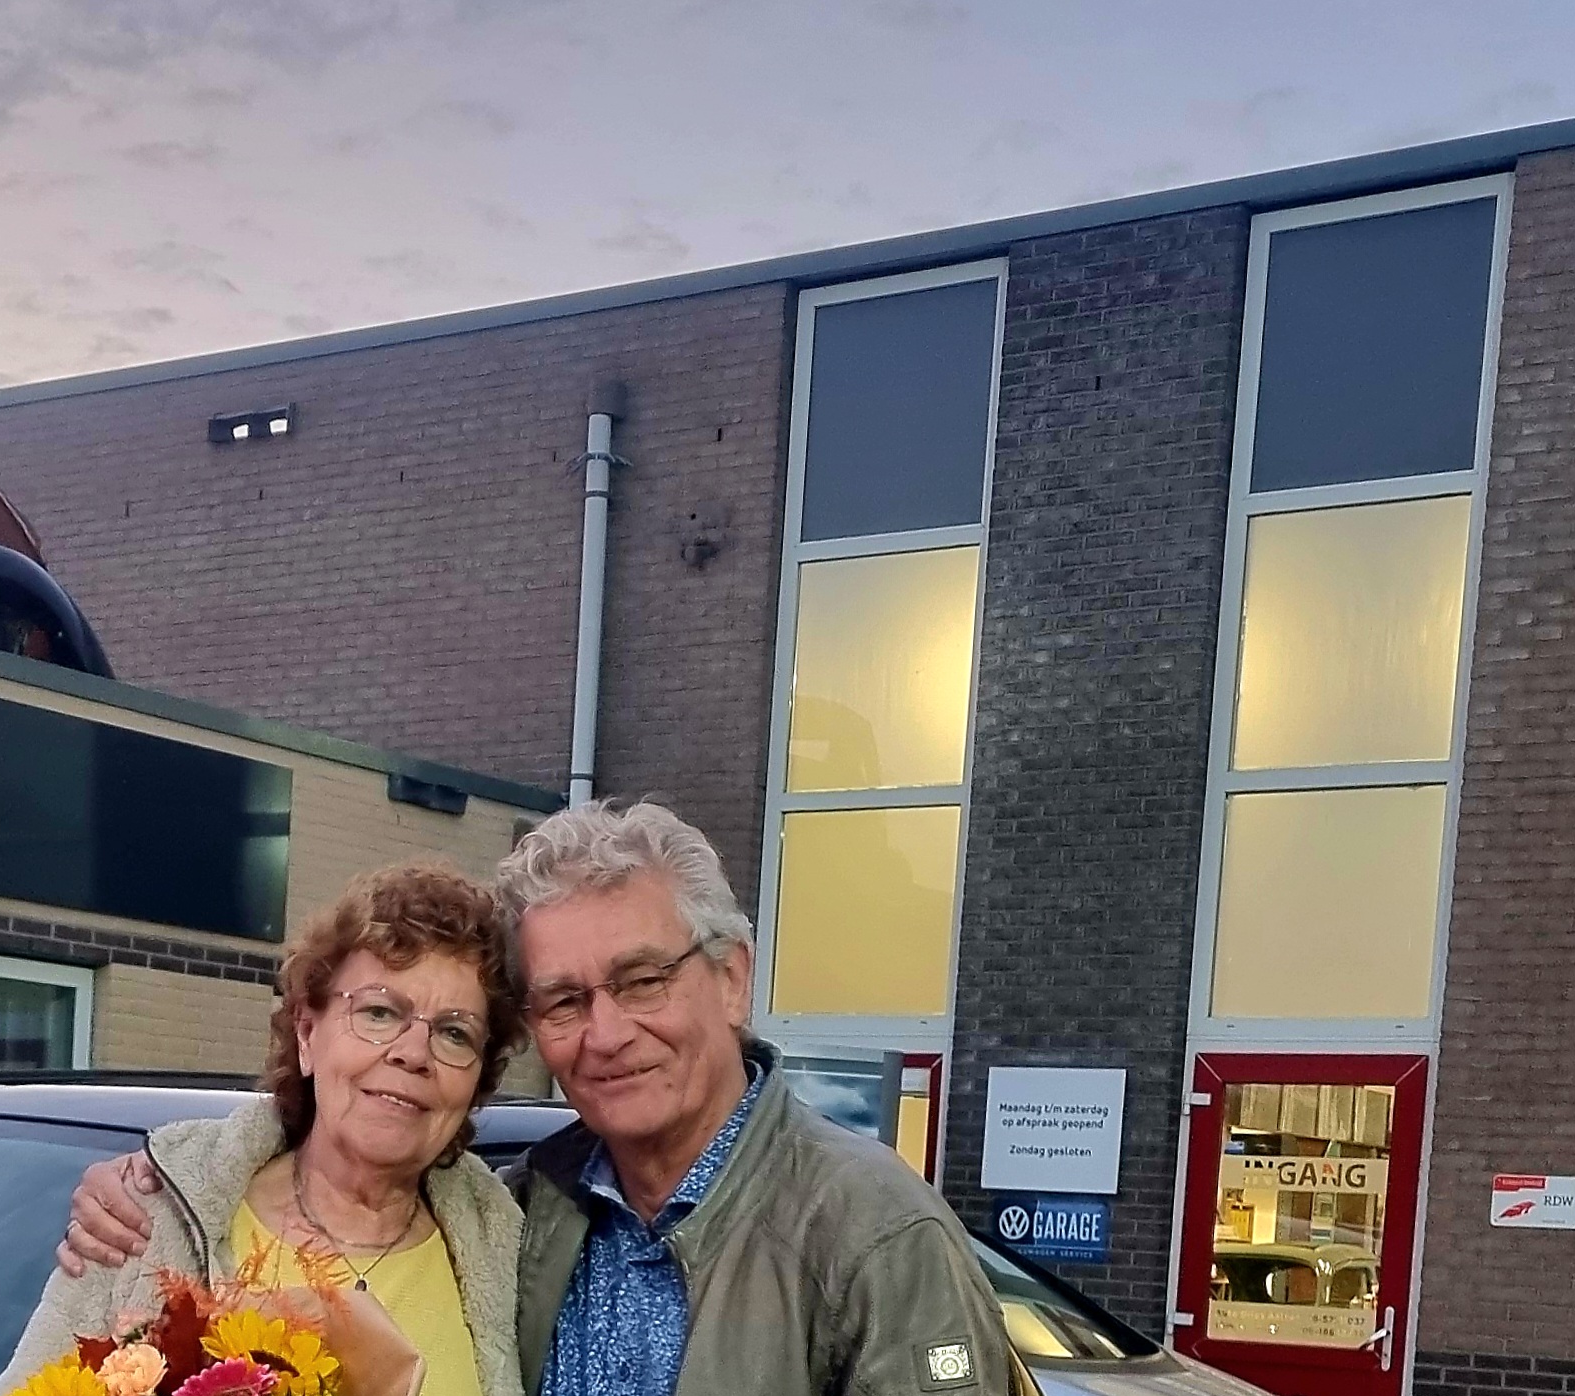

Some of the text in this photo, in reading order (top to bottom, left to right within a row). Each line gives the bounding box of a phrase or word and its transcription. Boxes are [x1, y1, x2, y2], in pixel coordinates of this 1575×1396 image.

[999, 1103, 1109, 1117] Maandag t/m zaterdag
[1002, 1117, 1104, 1131] op afspraak geopend
[1009, 1144, 1092, 1158] Zondag gesloten
[1543, 1195, 1573, 1207] RDW
[1033, 1211, 1102, 1242] GARAGE
